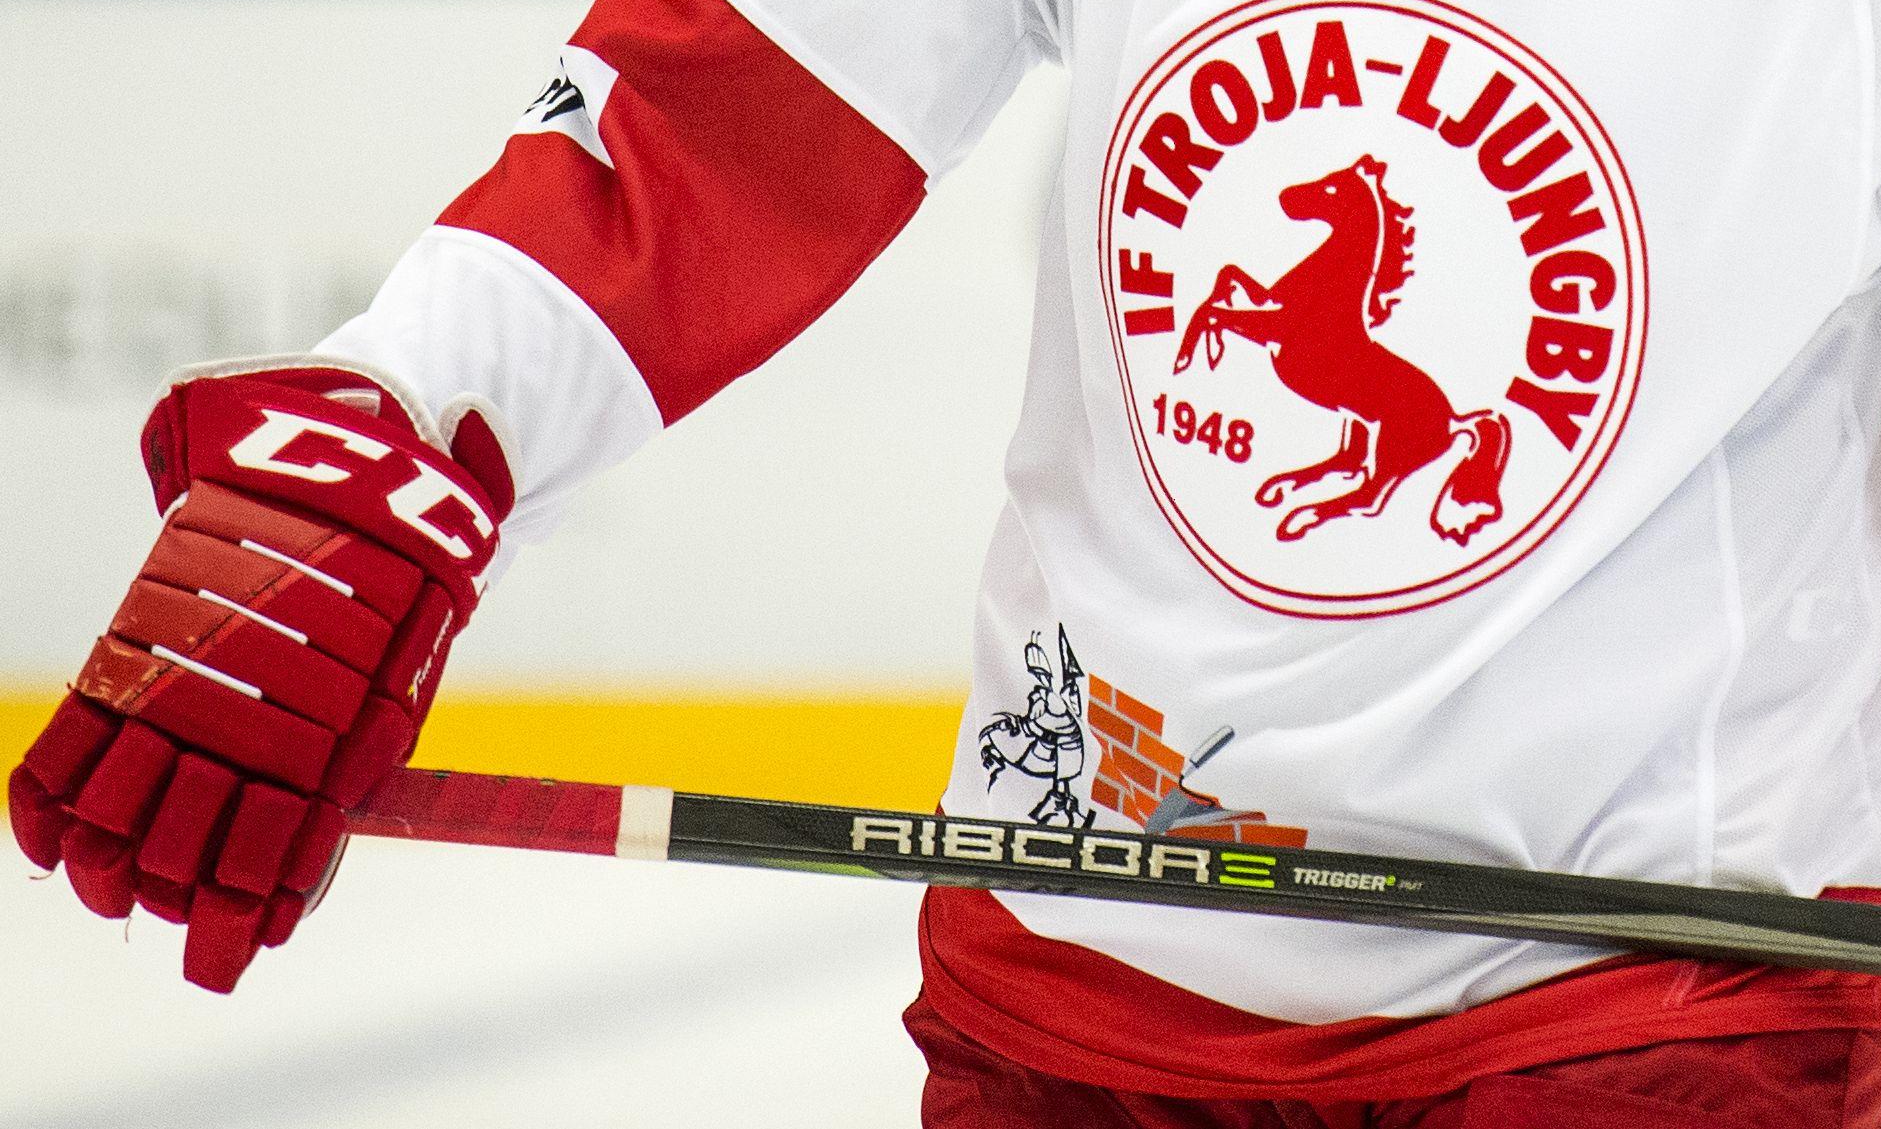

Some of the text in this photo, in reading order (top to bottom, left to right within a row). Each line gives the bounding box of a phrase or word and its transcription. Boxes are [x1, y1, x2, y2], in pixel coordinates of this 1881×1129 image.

[1118, 247, 1176, 337] IF
[1152, 392, 1255, 464] 1948
[227, 407, 494, 599] CC
